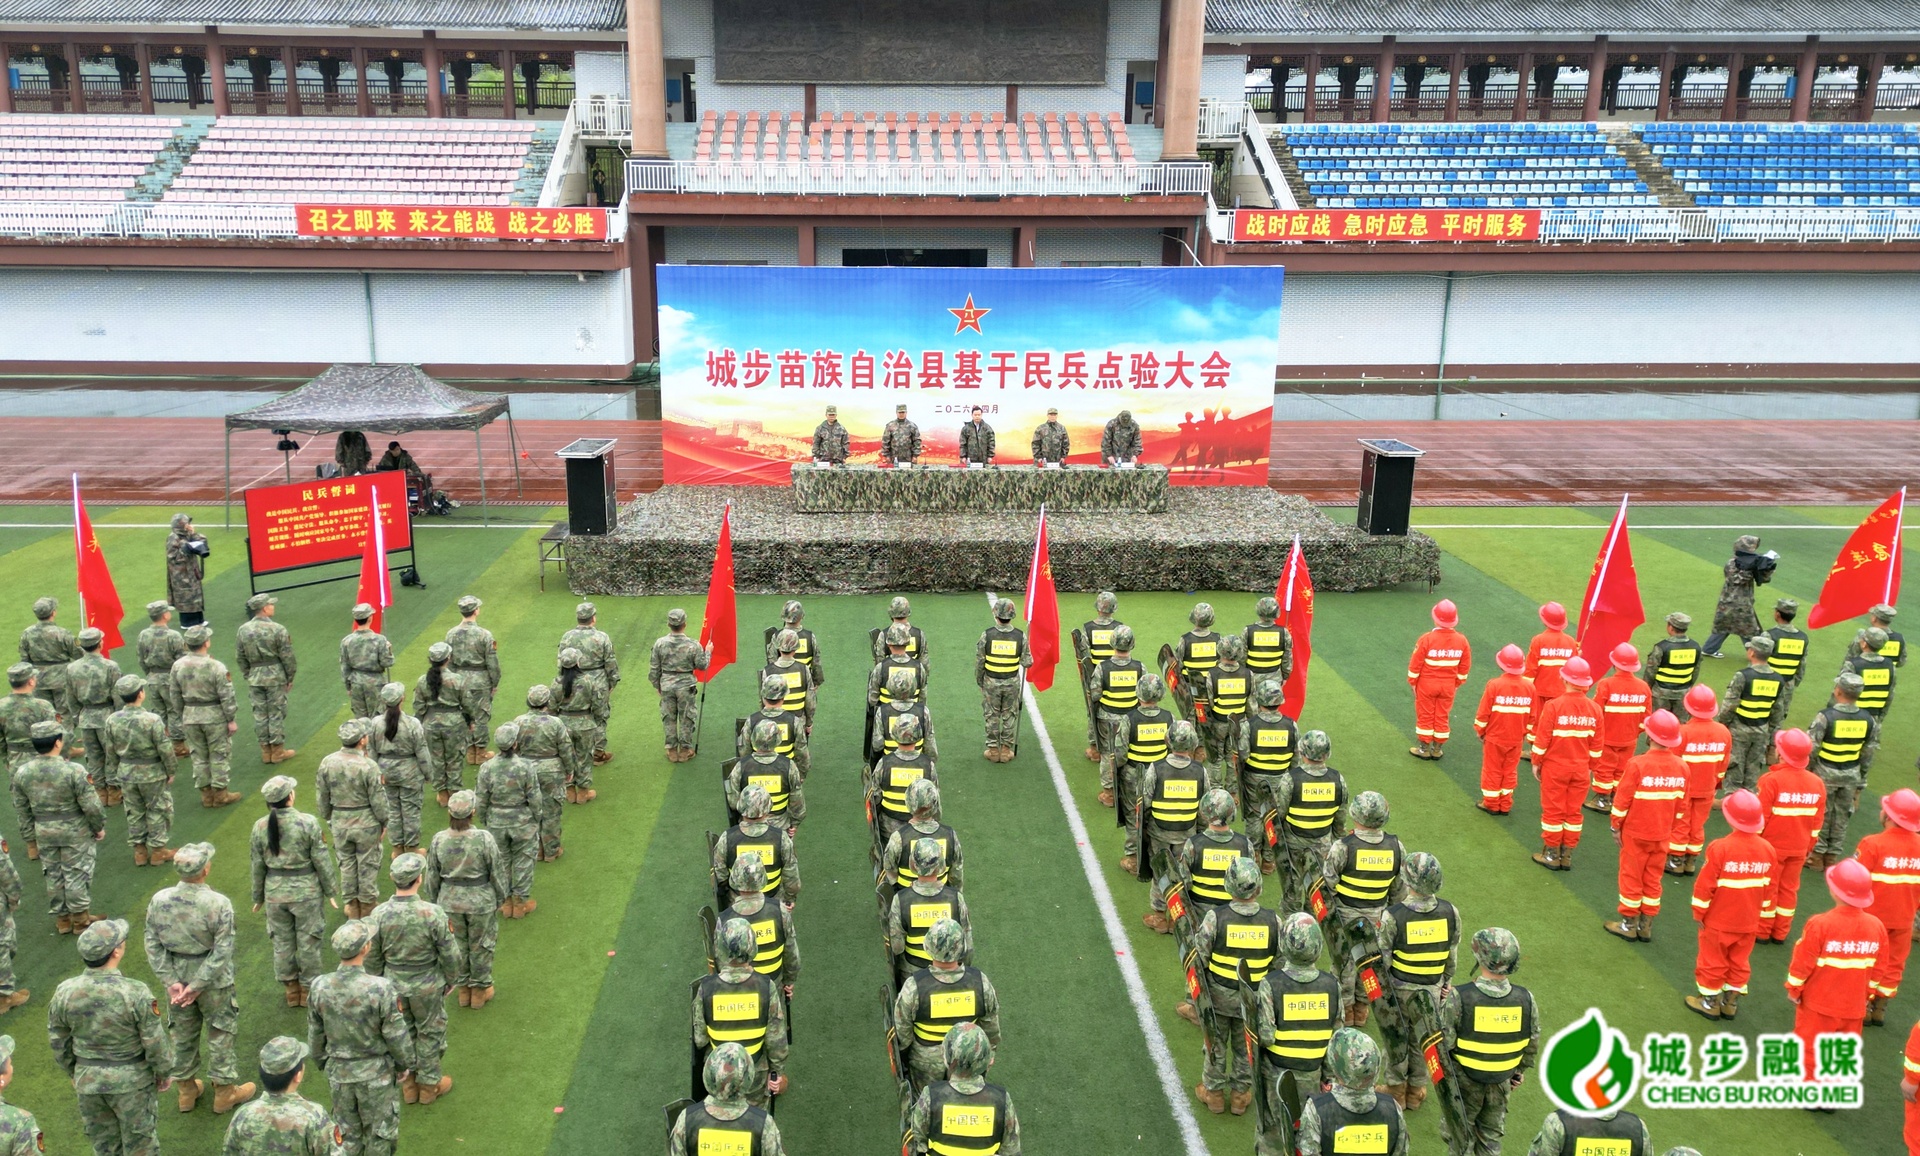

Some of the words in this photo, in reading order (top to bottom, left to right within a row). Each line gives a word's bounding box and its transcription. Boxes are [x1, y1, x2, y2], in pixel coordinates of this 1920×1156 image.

[309, 209, 397, 232] 召之即来
[409, 210, 496, 233] 来之能战
[508, 211, 595, 235] 战之必胜
[1246, 213, 1332, 237] 战时应战
[1343, 213, 1429, 236] 急时应急
[1441, 213, 1528, 236] 平时服务
[705, 348, 1232, 390] 城步苗族自治县基干民兵点验大会
[302, 484, 356, 501] 民兵誓词
[1427, 649, 1463, 658] 森林消防
[1540, 648, 1573, 657] 森林消防
[1495, 696, 1532, 706] 森林消防
[1610, 693, 1647, 704] 森林消防
[1557, 715, 1597, 727] 森林消防
[1685, 742, 1727, 753] 森林消防
[1641, 775, 1686, 788] 森林消防
[1303, 788, 1332, 796] 中国民兵
[1778, 792, 1821, 805] 森林消防
[1360, 857, 1393, 865] 中国民兵
[1724, 861, 1772, 874] 森林消防
[914, 910, 949, 919] 中国民兵
[755, 927, 773, 938] 民兵
[1229, 932, 1266, 940] 中国民兵
[1826, 940, 1879, 954] 森林消防
[716, 1002, 757, 1012] 中国民兵
[1287, 1001, 1327, 1011] 中国民兵
[946, 1114, 992, 1126] 中国民兵
[1582, 1147, 1629, 1156] 中国民兵
